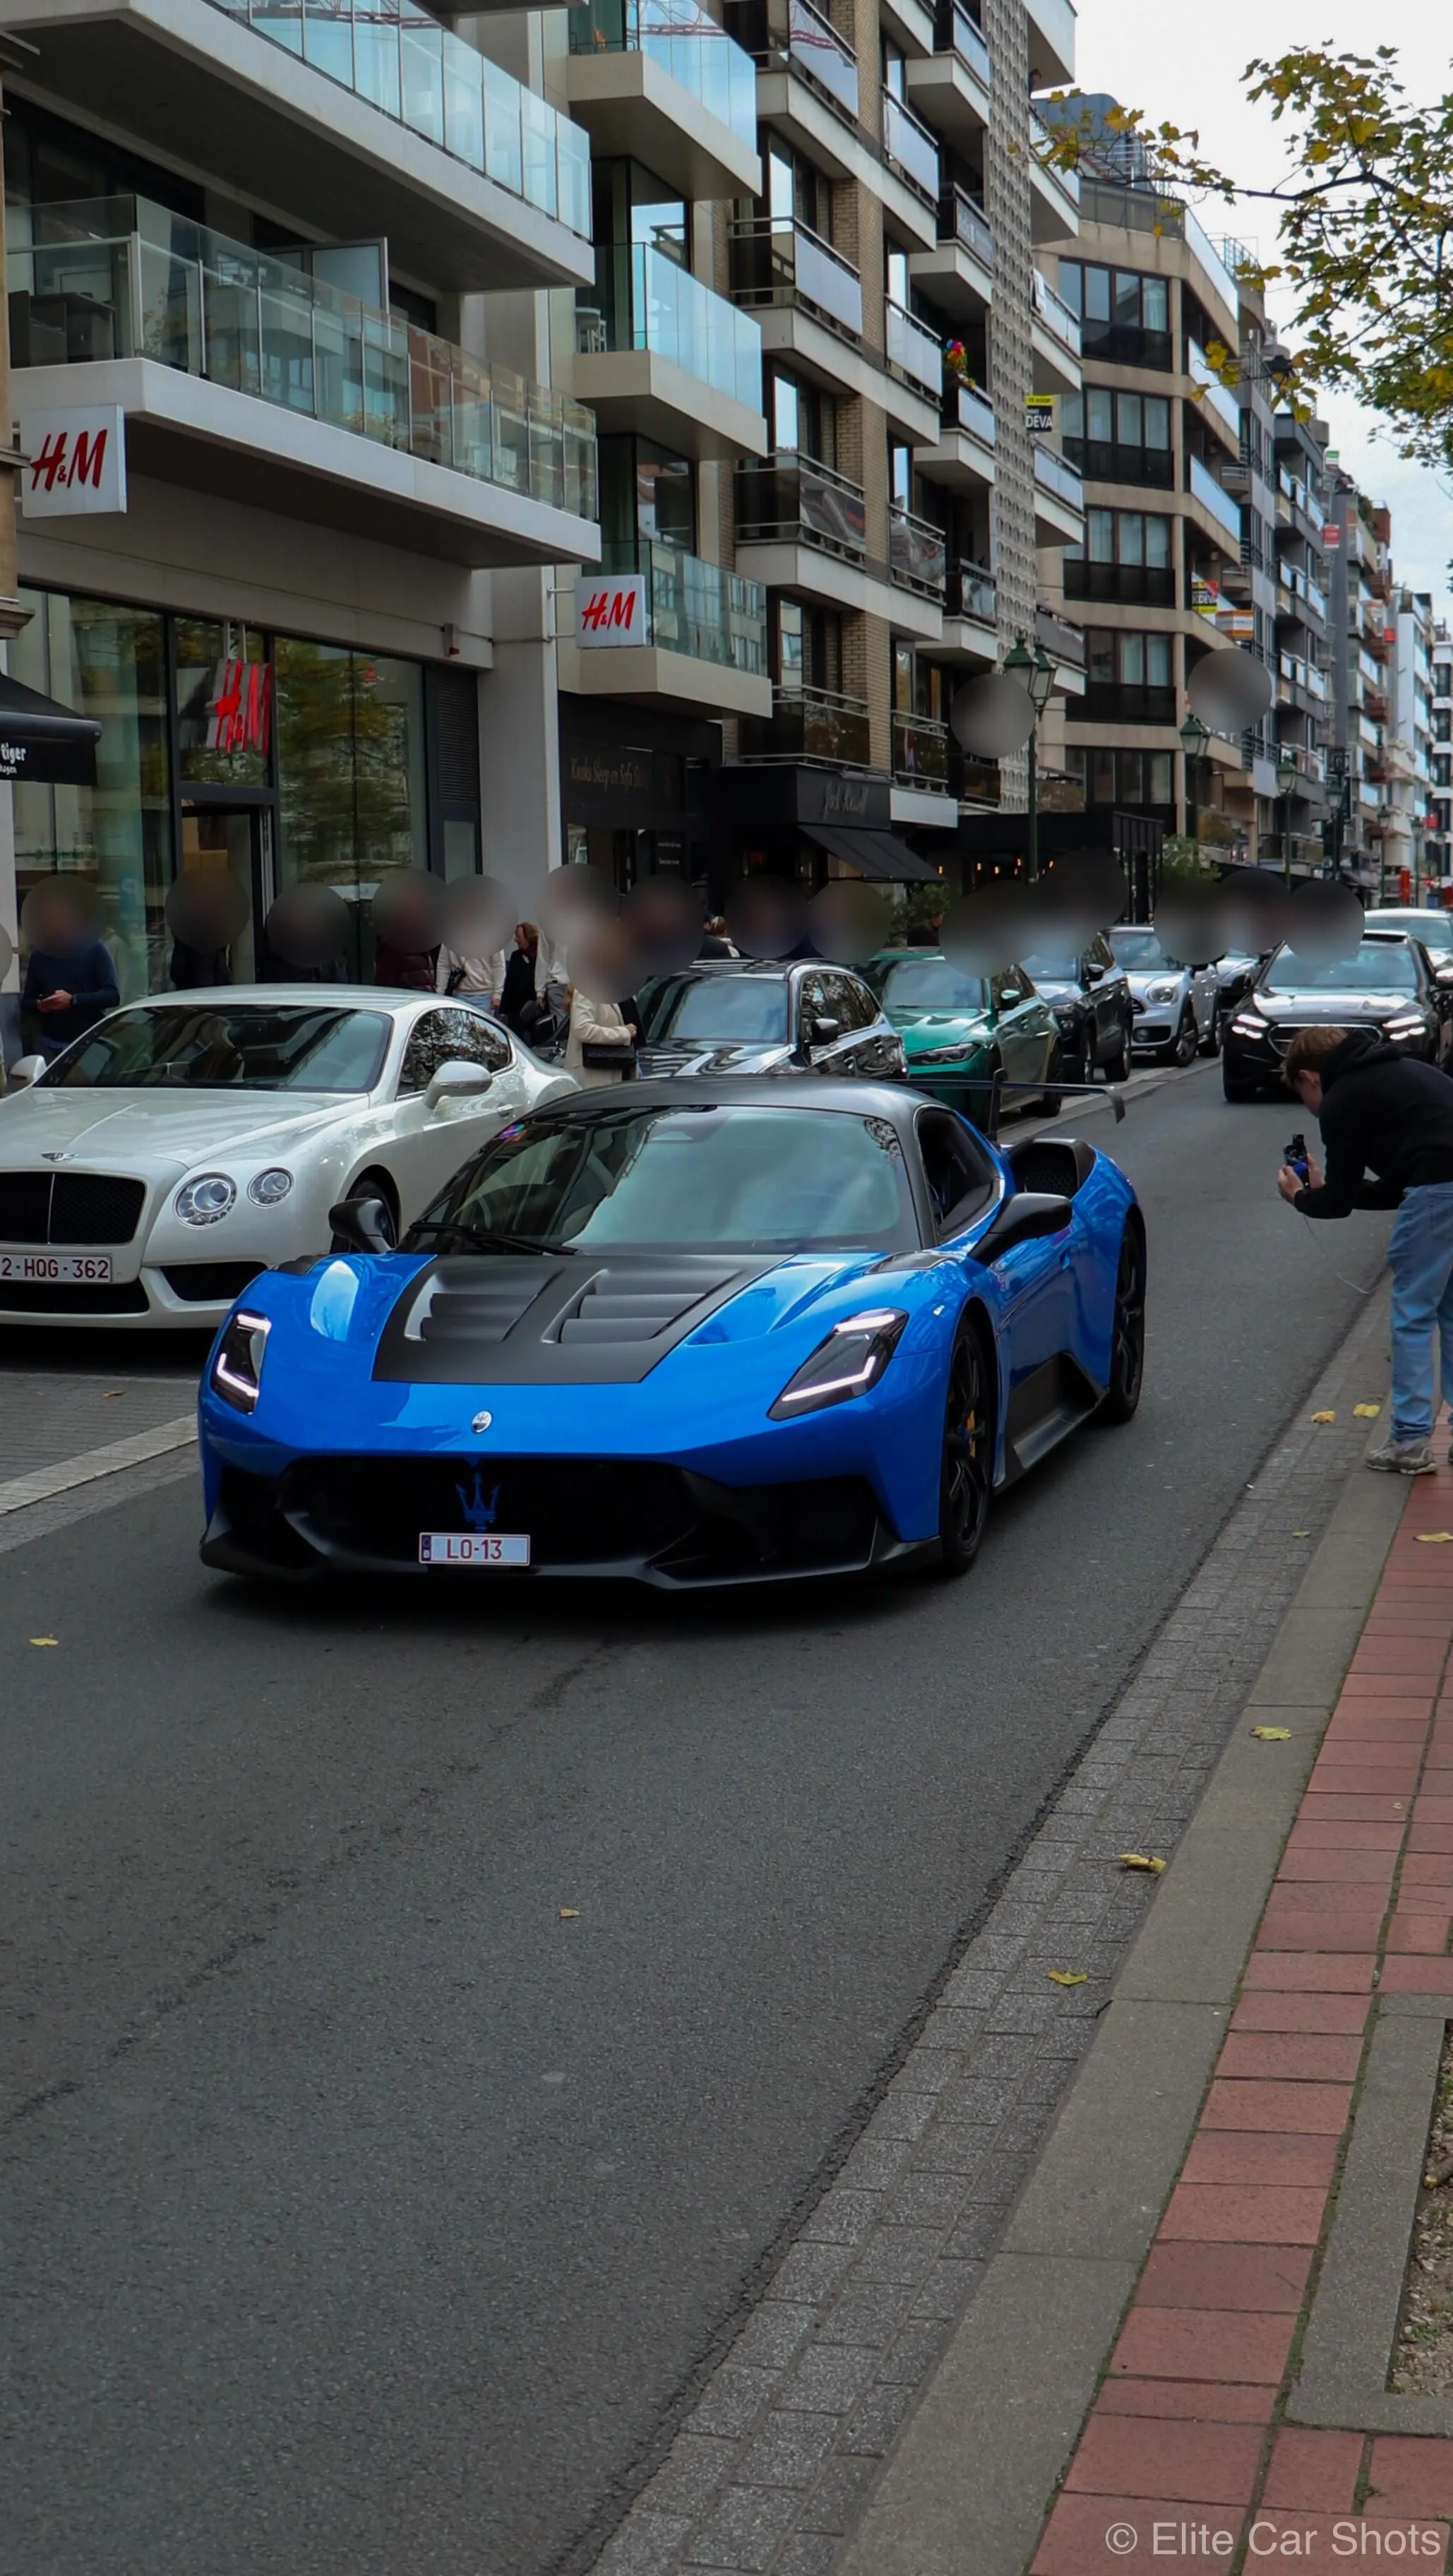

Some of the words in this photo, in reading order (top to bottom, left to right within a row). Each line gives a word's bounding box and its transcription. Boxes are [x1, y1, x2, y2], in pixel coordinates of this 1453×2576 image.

[1026, 415, 1053, 428] DEVA
[30, 429, 107, 491] H&M
[582, 590, 636, 632] H&M
[215, 657, 273, 758] H&M
[1, 741, 27, 764] tiger
[447, 1538, 502, 1560] LO-13
